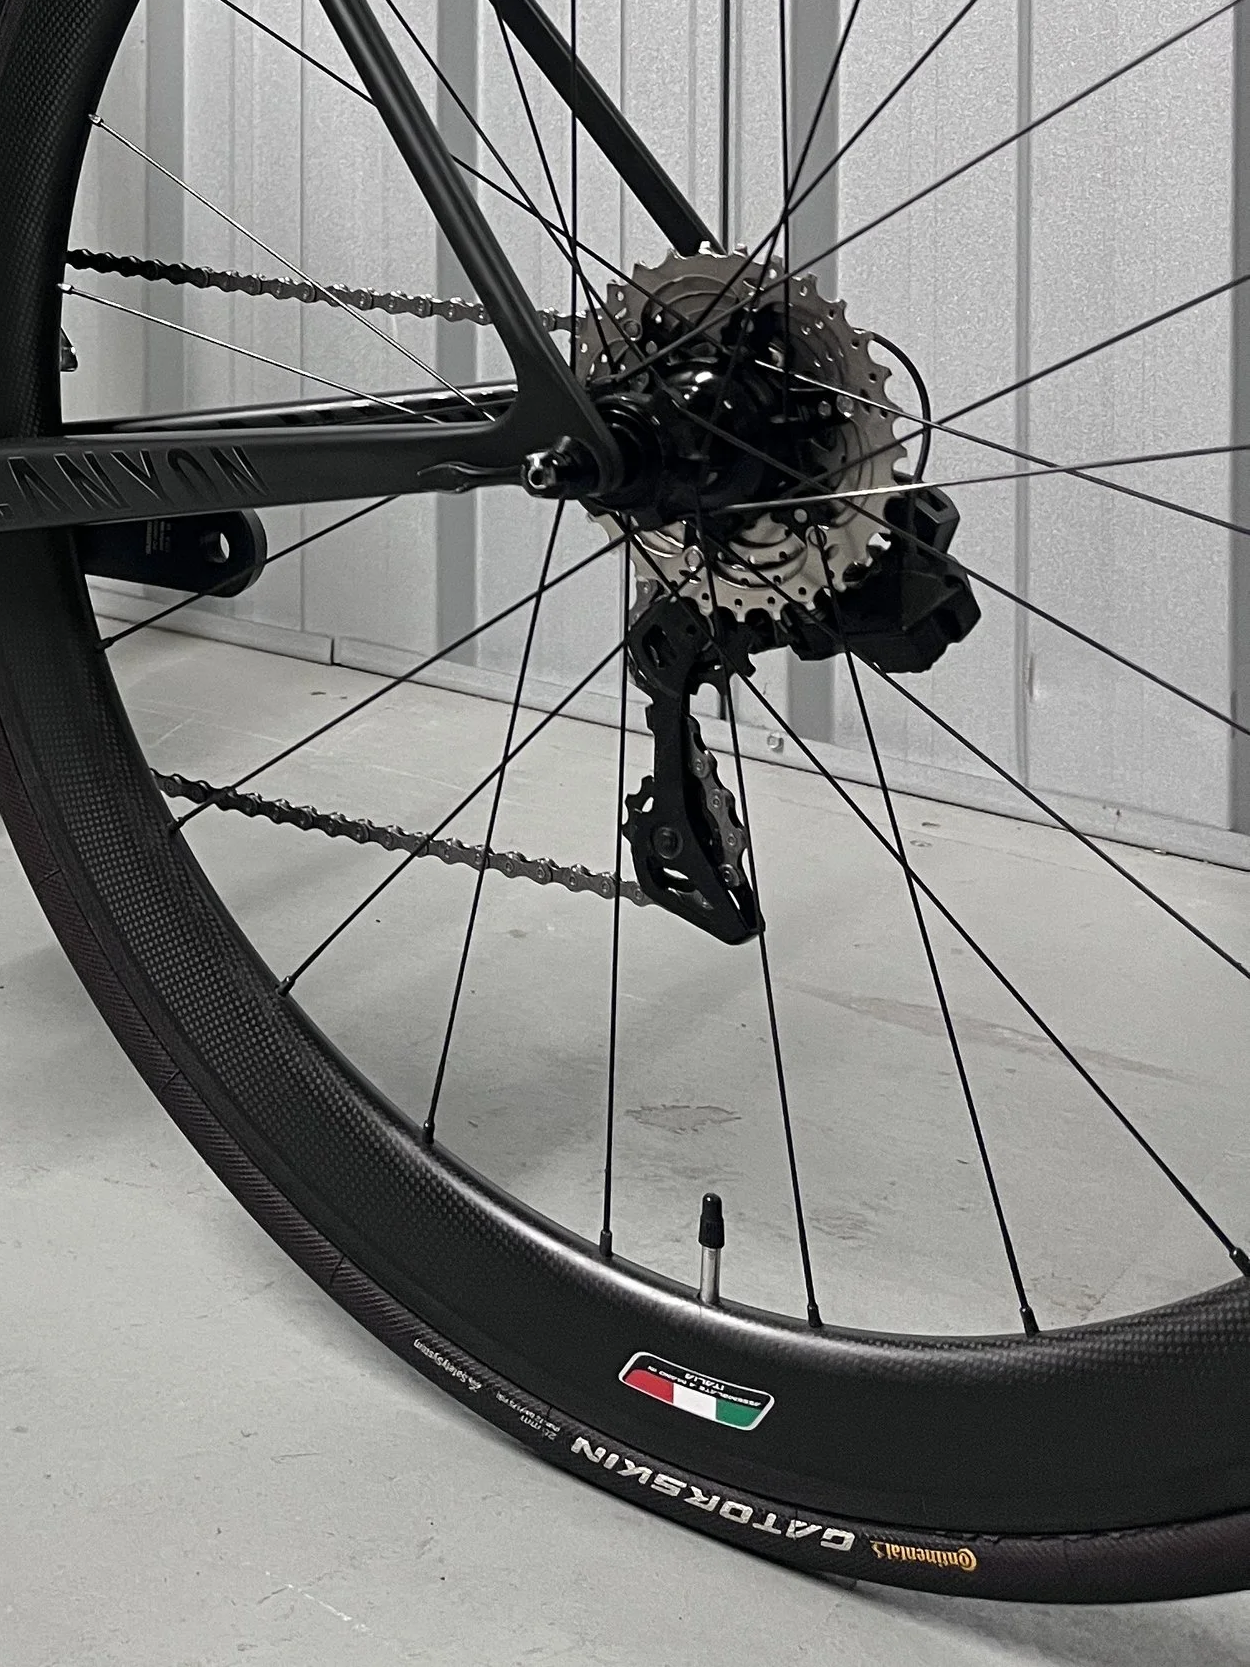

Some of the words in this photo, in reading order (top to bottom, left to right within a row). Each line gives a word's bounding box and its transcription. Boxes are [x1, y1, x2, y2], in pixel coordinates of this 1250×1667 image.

[684, 1373, 725, 1391] ITALIA
[569, 1436, 856, 1552] GATORSKIN
[885, 1541, 978, 1572] Continental
